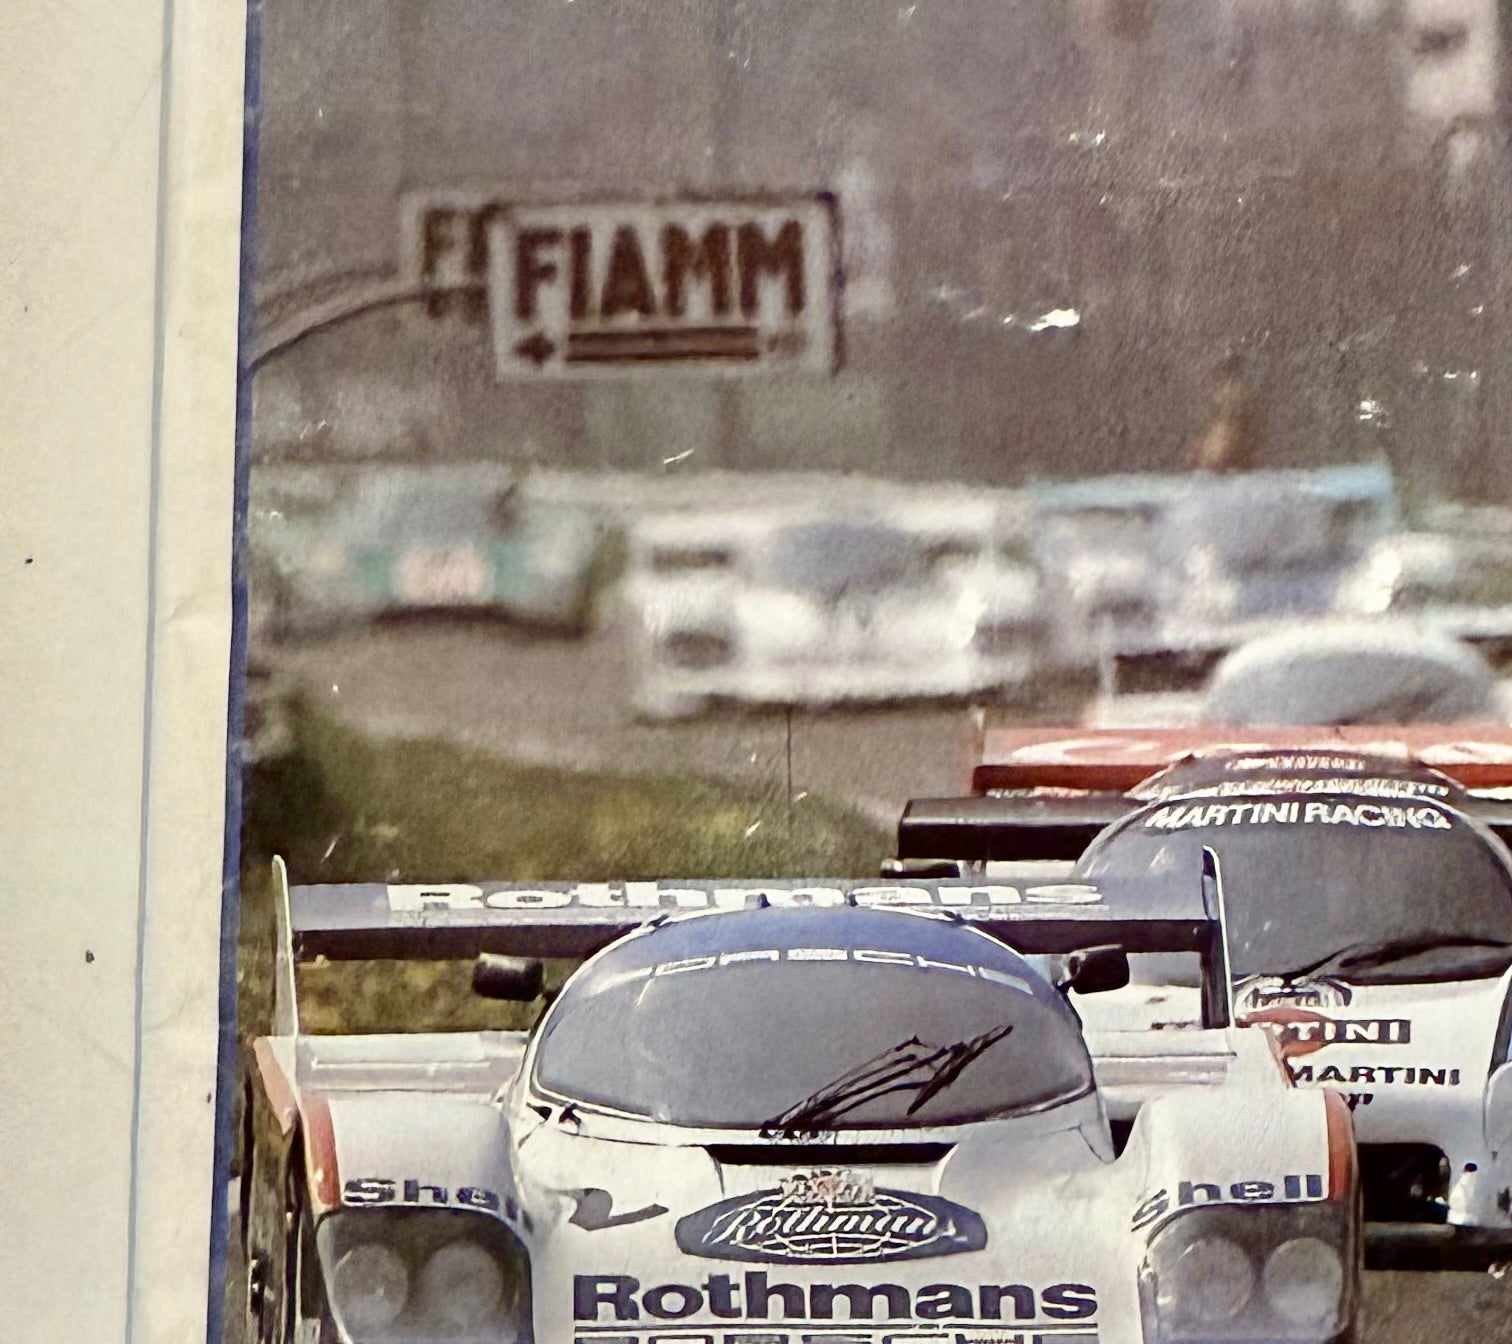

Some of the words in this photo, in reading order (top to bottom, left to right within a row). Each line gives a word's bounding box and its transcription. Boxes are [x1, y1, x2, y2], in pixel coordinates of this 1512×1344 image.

[512, 219, 806, 320] FIAMM
[1145, 803, 1300, 829] MARTINI
[1131, 1173, 1323, 1232] Shell
[573, 1270, 1098, 1321] Rothmans
